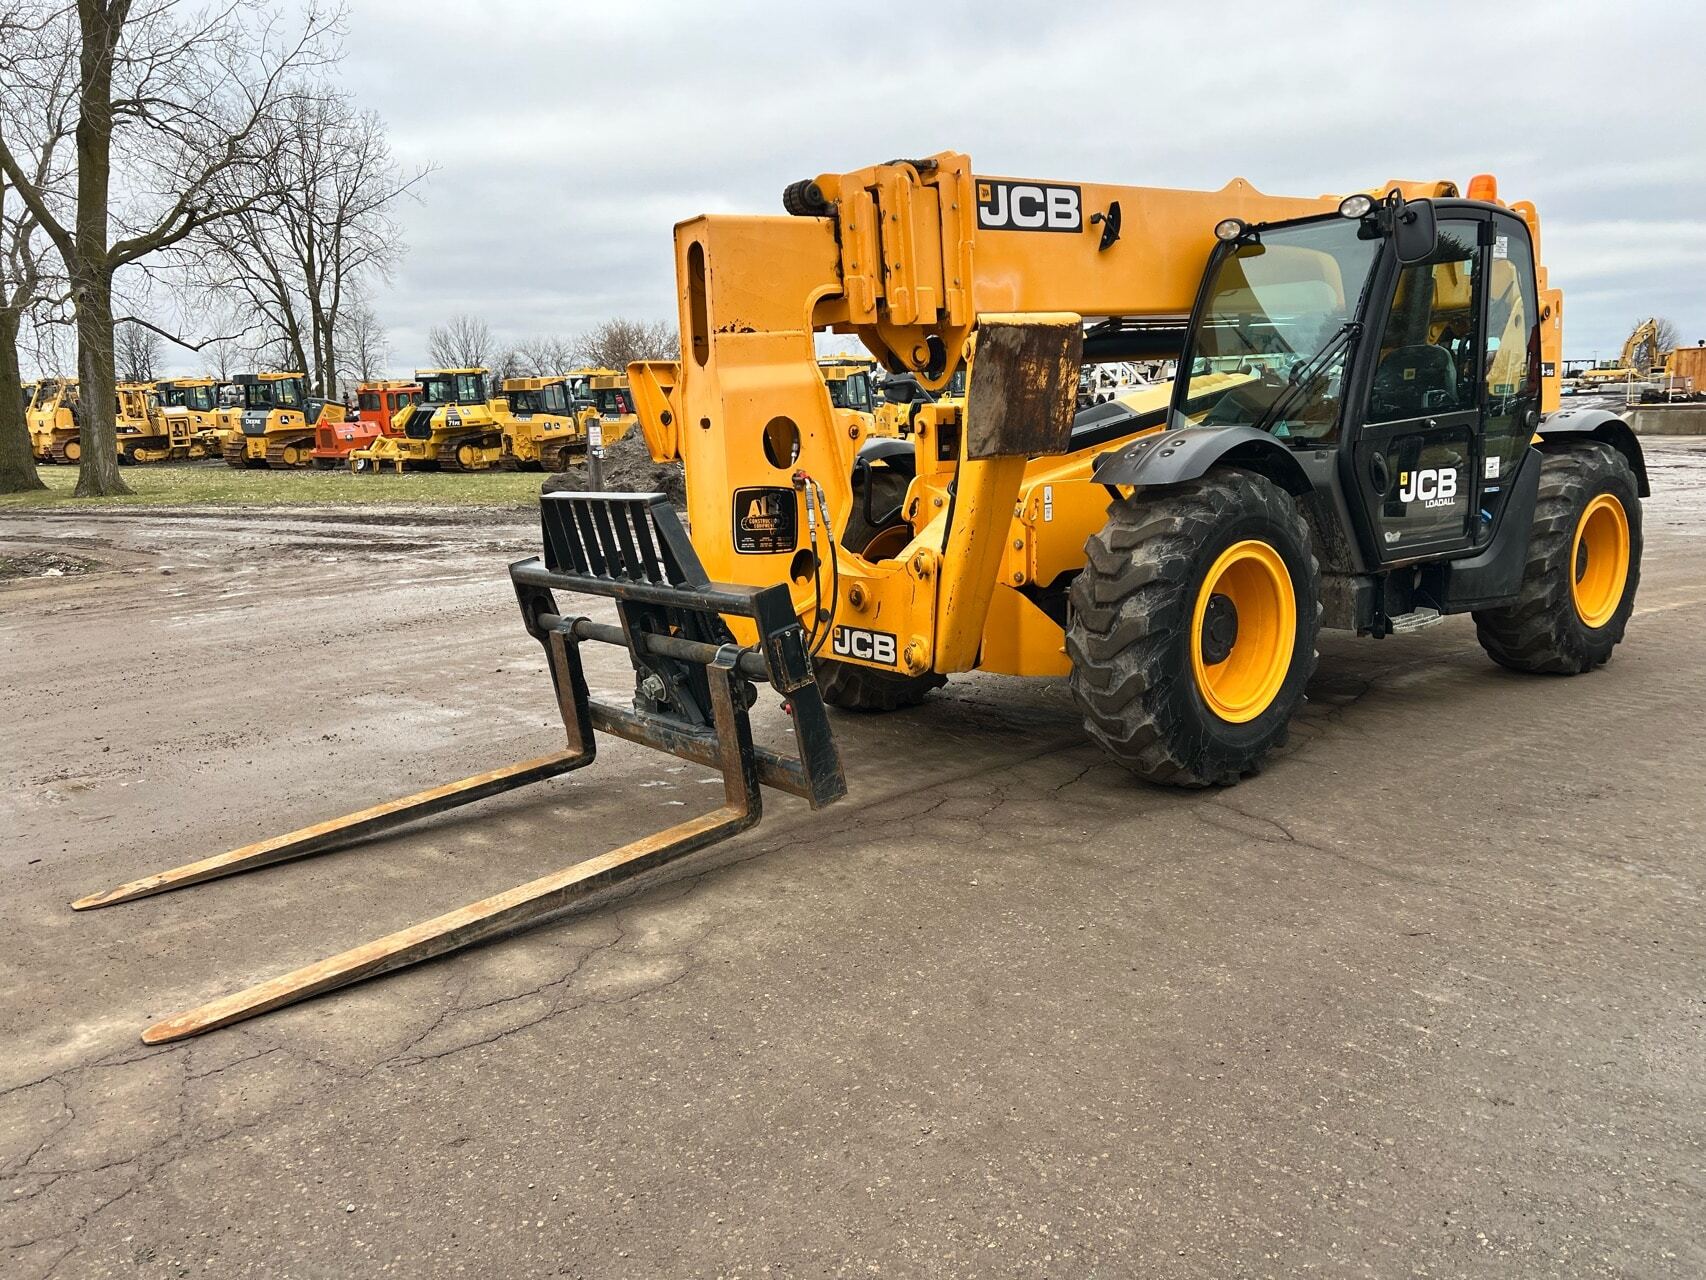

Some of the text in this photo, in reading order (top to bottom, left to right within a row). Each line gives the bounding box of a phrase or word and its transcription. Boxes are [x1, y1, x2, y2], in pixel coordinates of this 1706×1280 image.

[980, 184, 1080, 228] JCB
[1399, 468, 1457, 503] JCB
[1425, 497, 1456, 509] LOADALL
[834, 628, 896, 663] JCB
